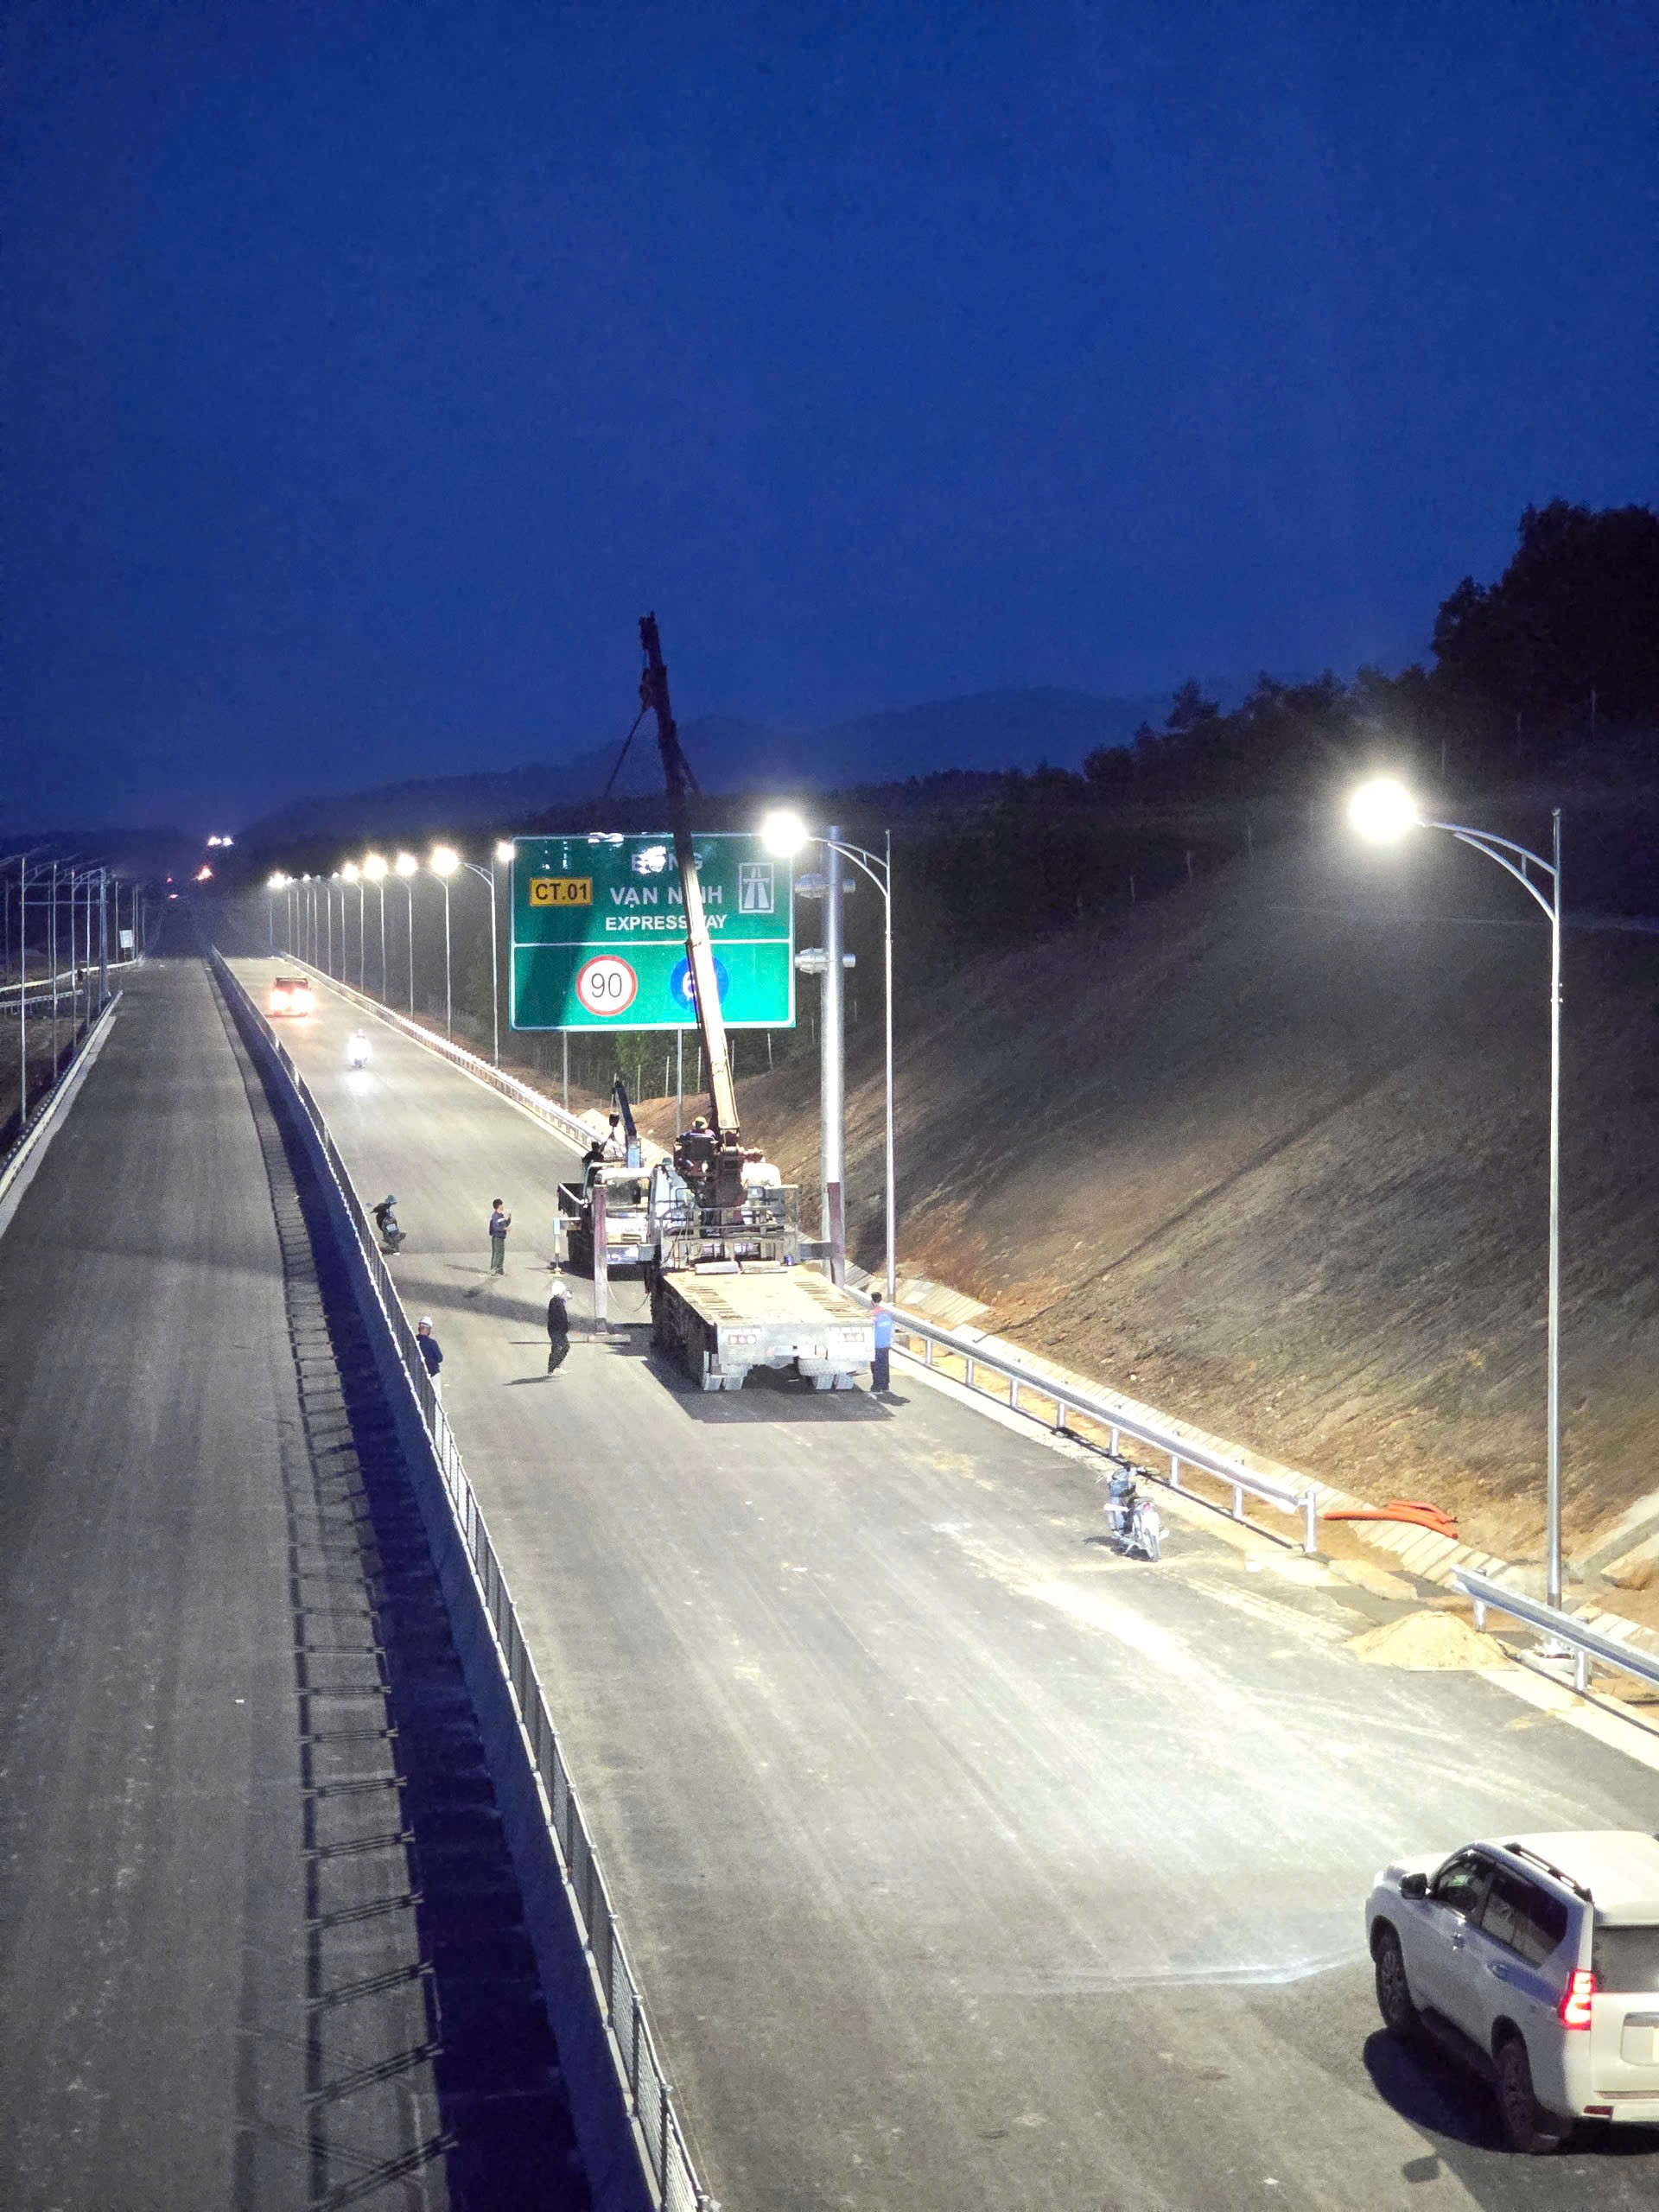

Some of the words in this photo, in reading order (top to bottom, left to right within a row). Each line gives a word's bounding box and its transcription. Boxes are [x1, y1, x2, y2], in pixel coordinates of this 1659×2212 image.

[535, 883, 588, 900] CT.01
[610, 887, 658, 908] VẠN
[606, 914, 728, 931] EXPRESSAY
[591, 973, 622, 998] 90
